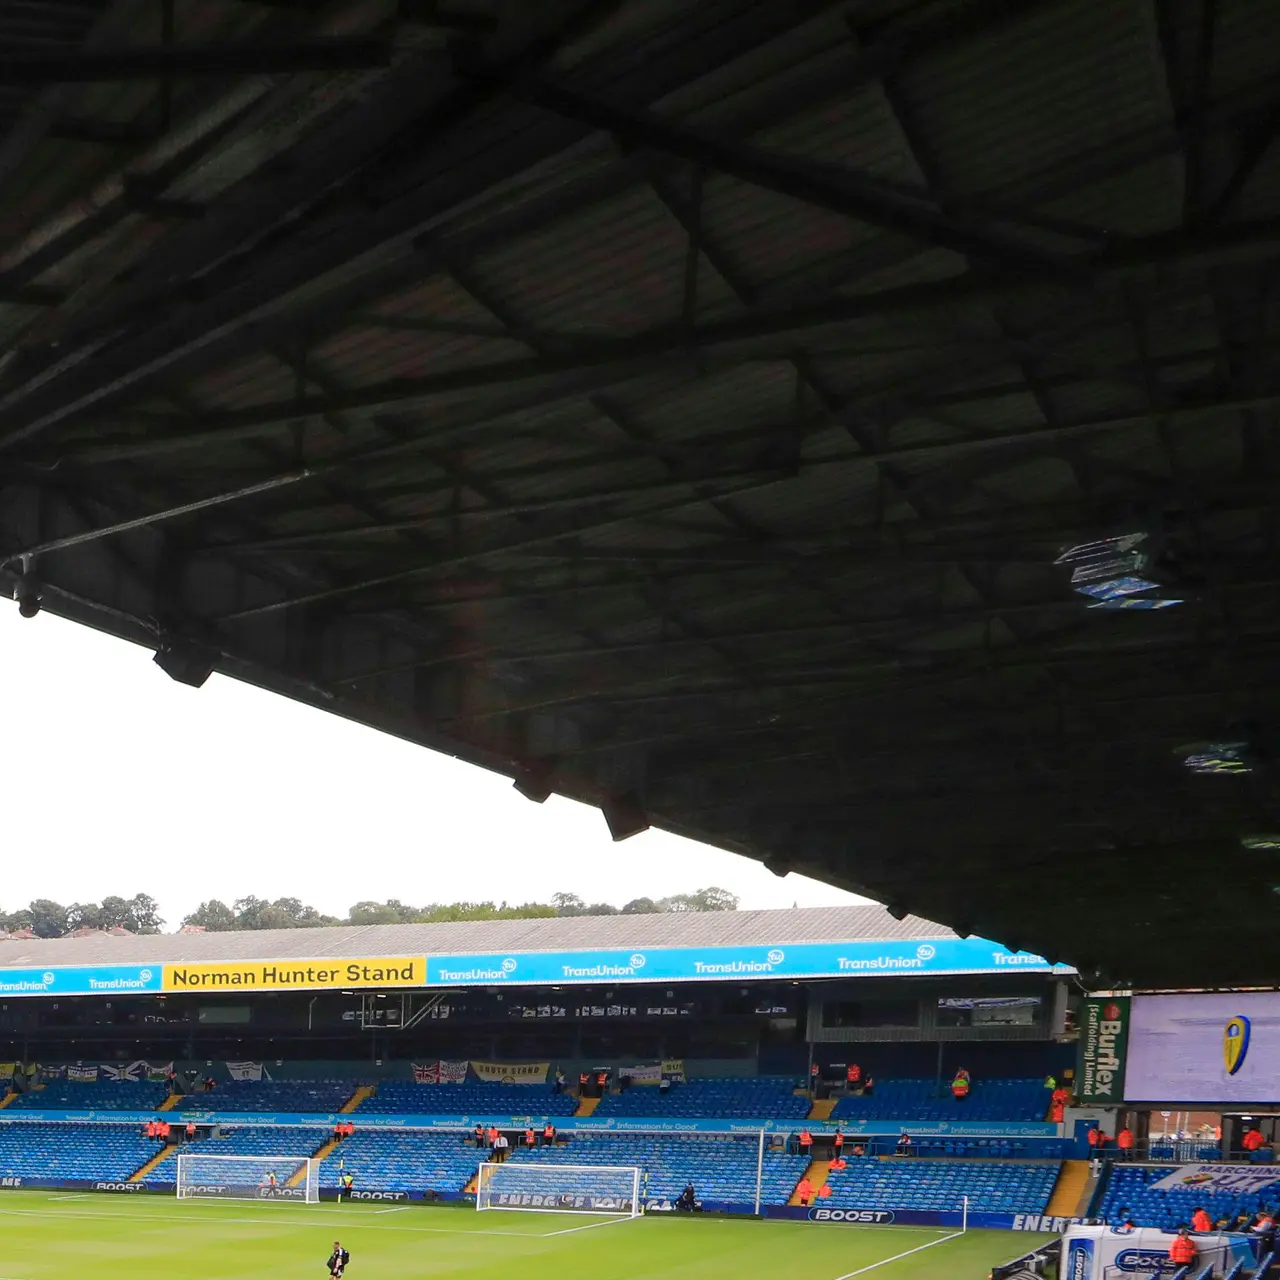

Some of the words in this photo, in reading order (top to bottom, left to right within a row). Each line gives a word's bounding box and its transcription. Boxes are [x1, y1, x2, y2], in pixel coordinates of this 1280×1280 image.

[694, 961, 772, 973] TransUnion
[837, 957, 922, 969] TransUnion
[173, 965, 256, 986] Norman
[263, 963, 337, 984] Hunter
[345, 961, 414, 982] Stand
[439, 968, 507, 980] TransUnion
[562, 965, 634, 977] TransUnion
[89, 978, 145, 990] TransUnion
[1084, 1004, 1099, 1059] (Scaffolding)
[1095, 1020, 1121, 1096] Burflex
[1084, 1062, 1092, 1096] Limited
[815, 1209, 888, 1222] BOOST
